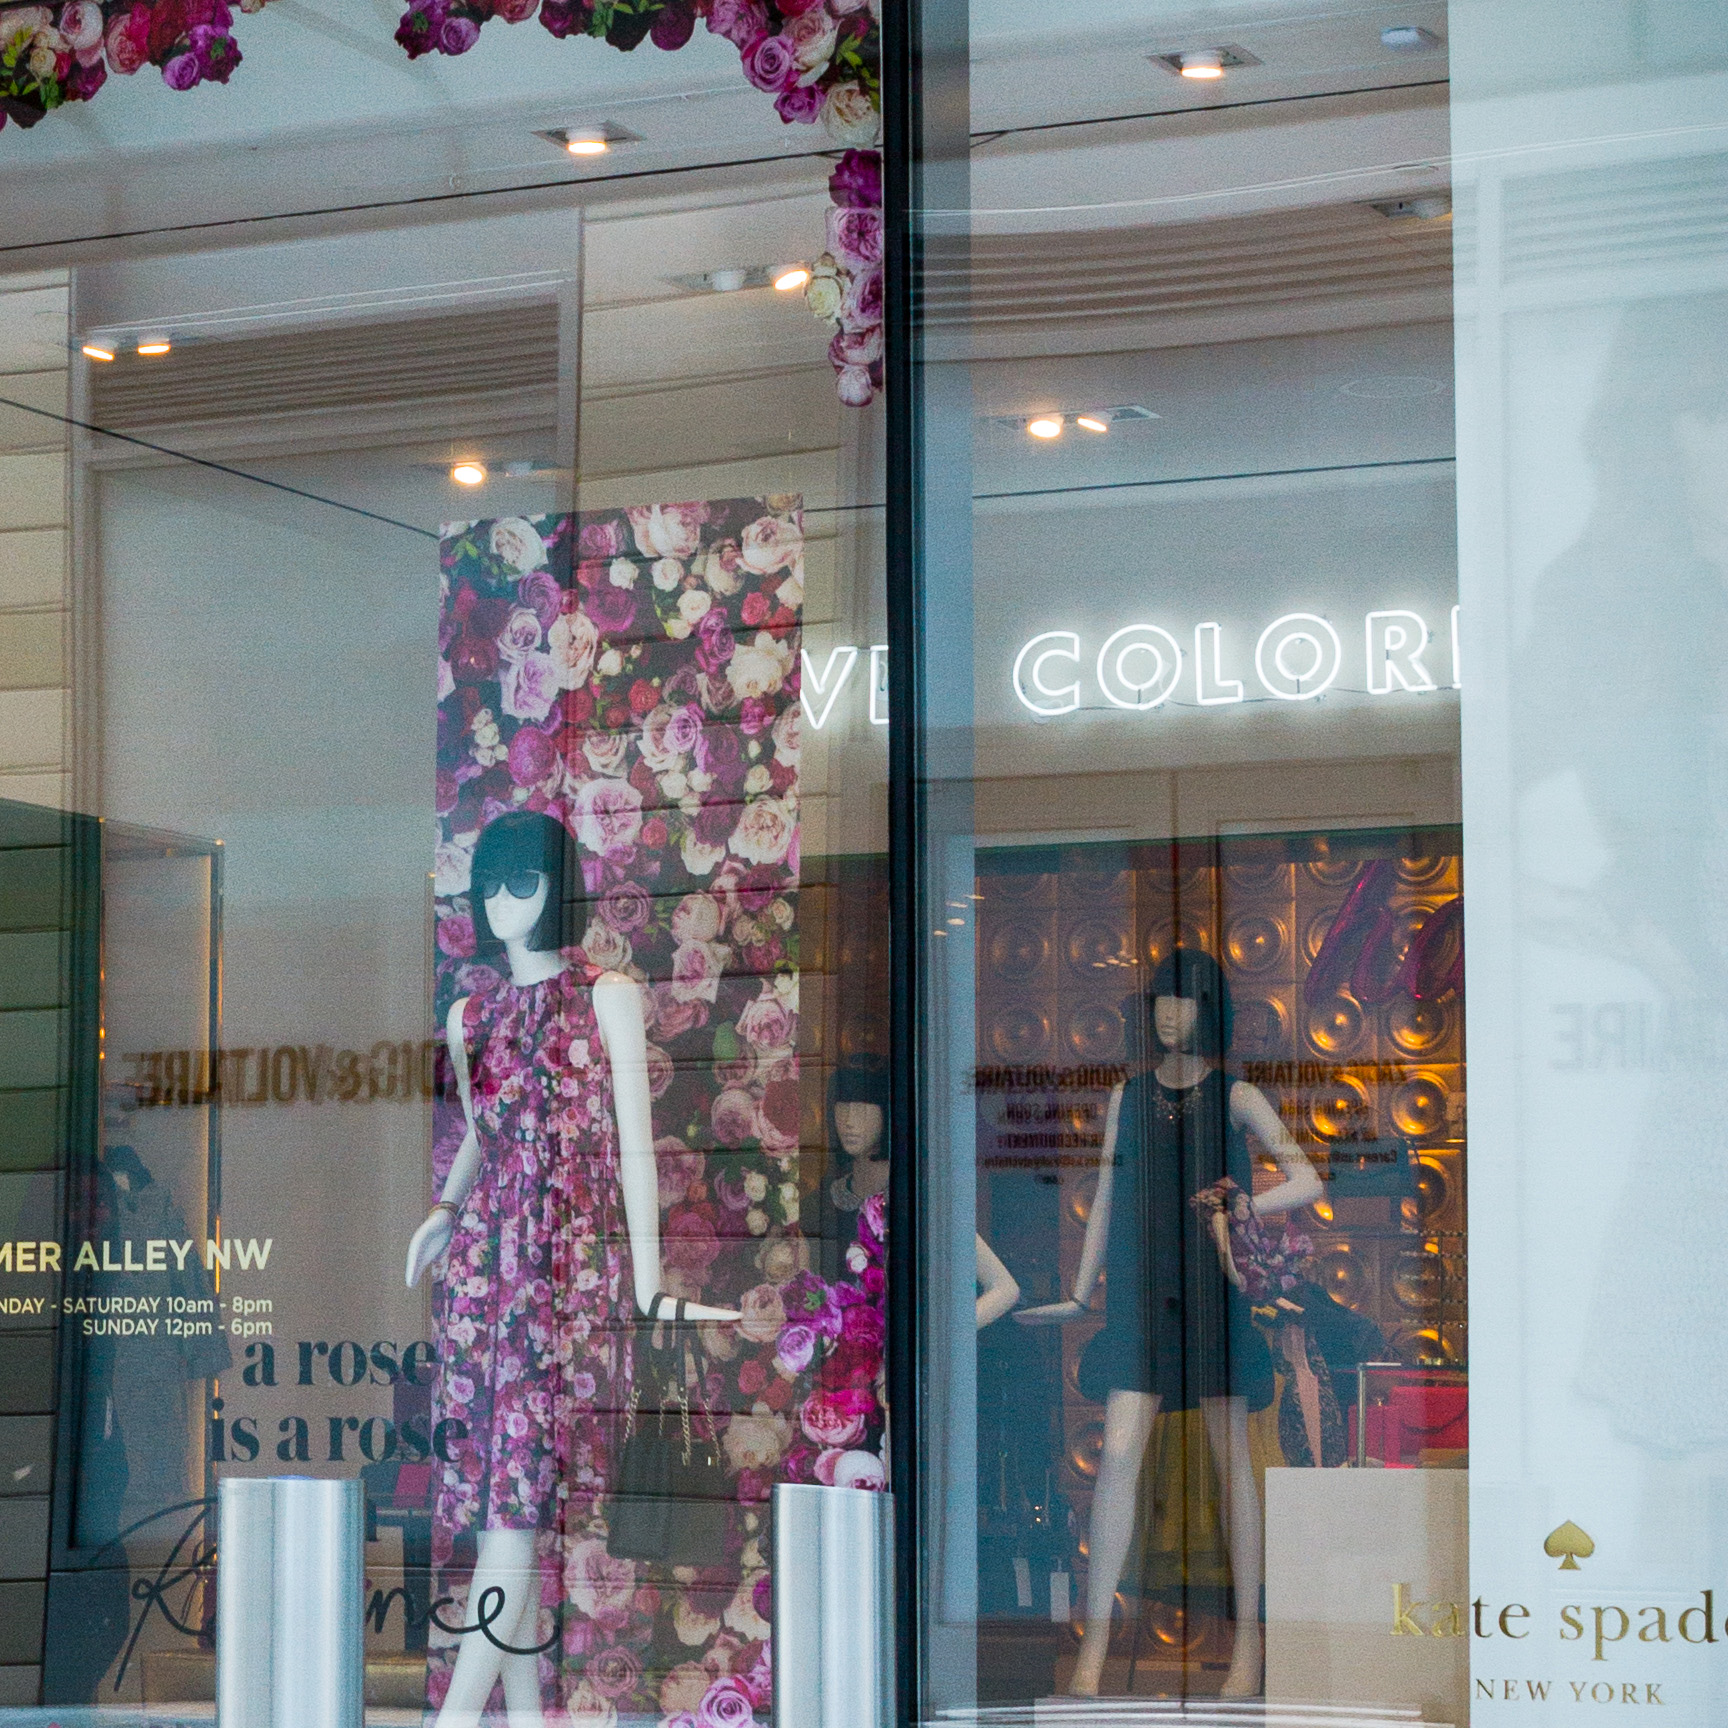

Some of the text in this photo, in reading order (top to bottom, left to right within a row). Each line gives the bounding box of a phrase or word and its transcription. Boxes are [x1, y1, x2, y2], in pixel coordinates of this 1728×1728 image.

[1012, 604, 1462, 717] COLOR
[75, 1239, 194, 1271] ALLEY
[206, 1238, 273, 1270] NW
[63, 1297, 160, 1314] SATURDAY
[167, 1297, 214, 1314] 10am
[232, 1297, 273, 1318] 8pm
[83, 1319, 157, 1336] SUNDAY
[164, 1319, 213, 1339] 12pm
[231, 1319, 273, 1339] 6pm
[242, 1341, 440, 1387] a rose
[210, 1396, 469, 1463] is a rose
[1389, 1582, 1728, 1661] kate spad
[1475, 1678, 1665, 1706] NEW YORK
